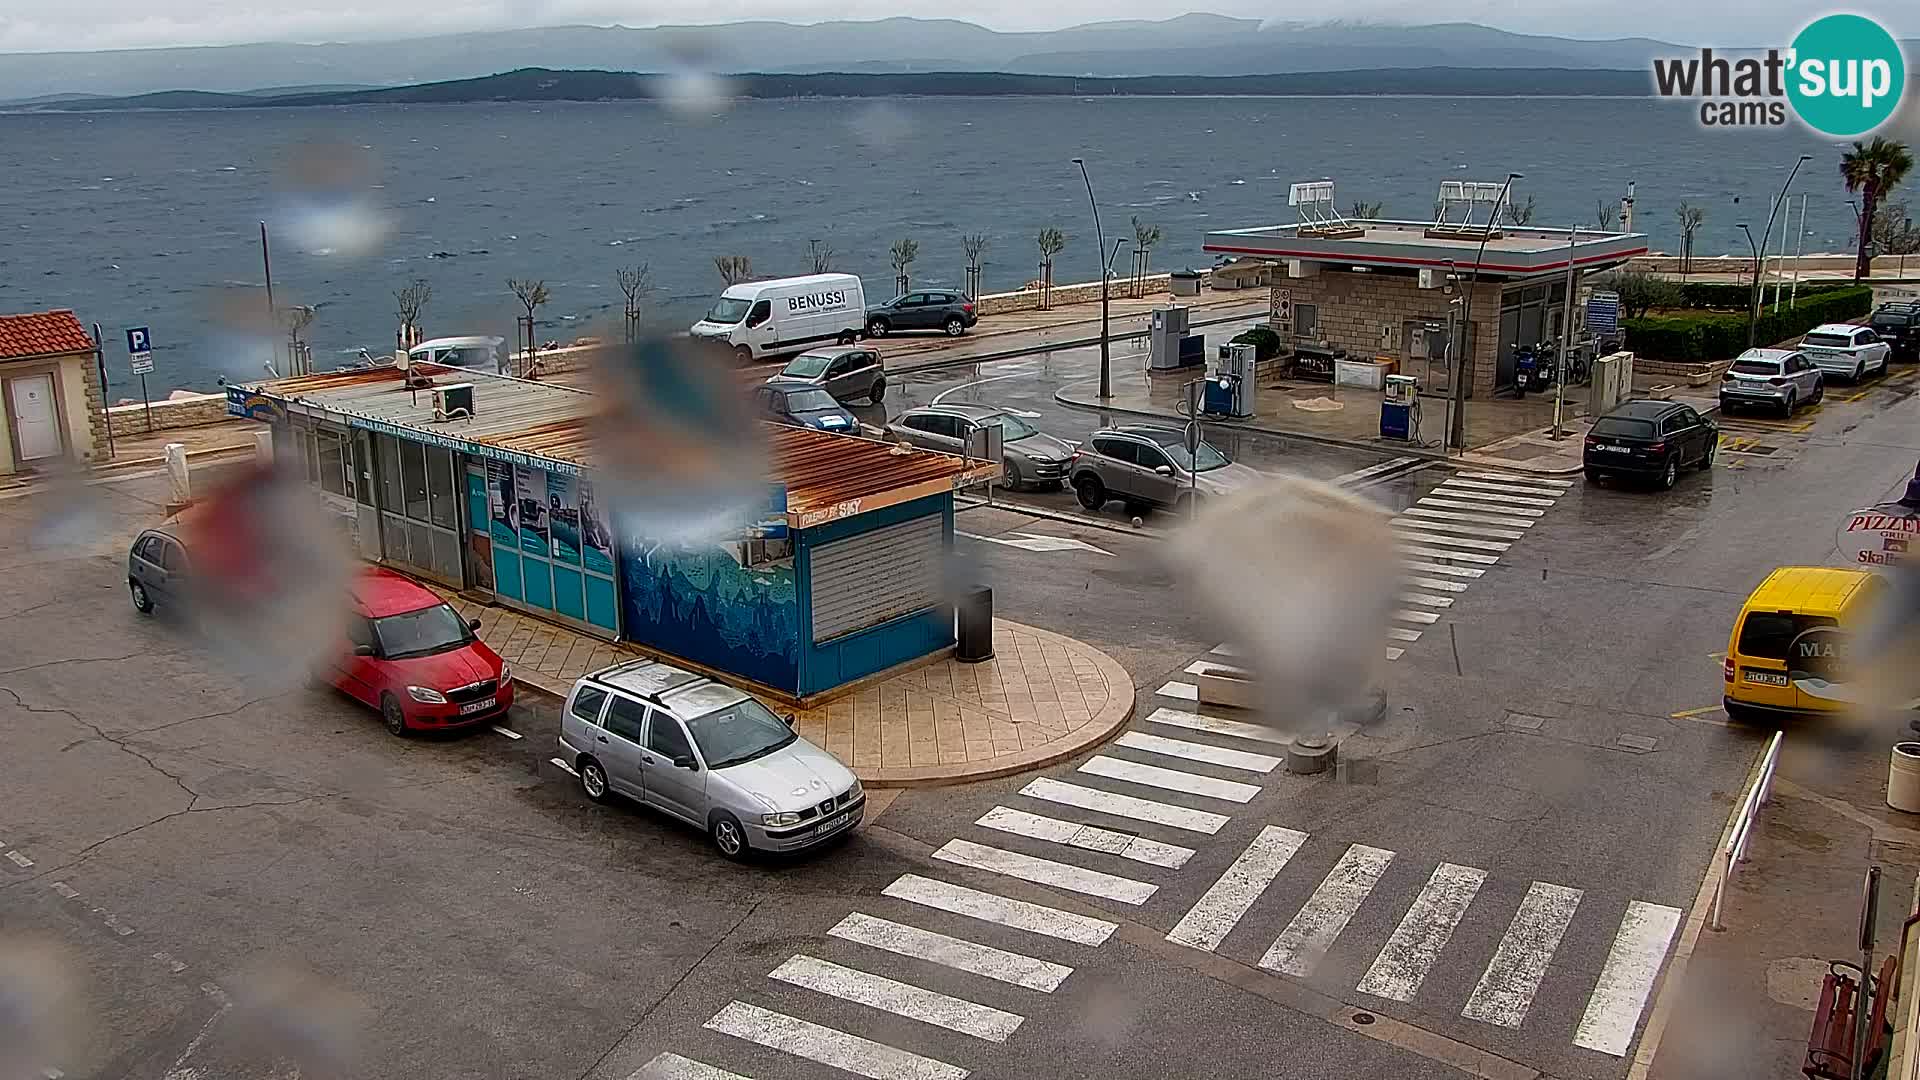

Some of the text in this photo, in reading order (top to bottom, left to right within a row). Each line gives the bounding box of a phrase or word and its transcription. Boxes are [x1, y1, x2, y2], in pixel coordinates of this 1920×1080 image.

[788, 290, 846, 310] BENUSSI
[131, 331, 145, 350] P
[397, 427, 437, 445] AUTOBUSNA
[438, 436, 469, 452] POSTAJA
[480, 445, 494, 457] BUS
[495, 448, 527, 465] STATION
[529, 456, 555, 471] TICKET
[557, 462, 583, 477] OFFICE
